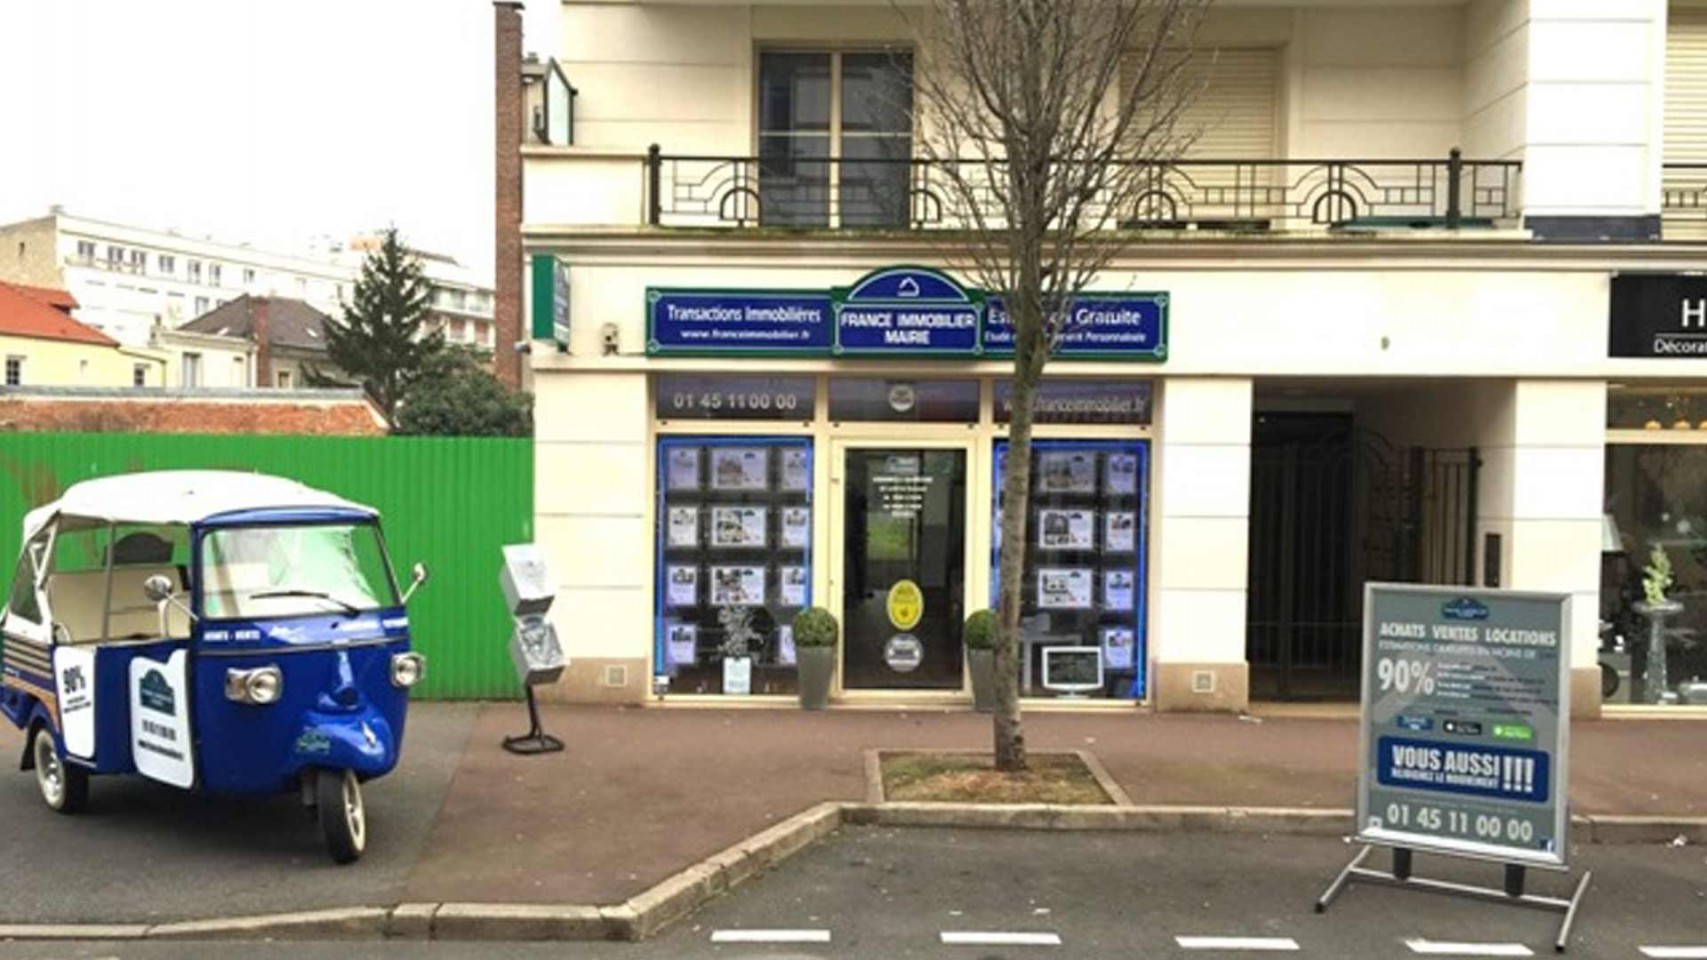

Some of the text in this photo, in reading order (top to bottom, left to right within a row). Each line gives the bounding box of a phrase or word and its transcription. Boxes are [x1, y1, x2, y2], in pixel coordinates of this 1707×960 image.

[667, 303, 742, 321] Transactions
[841, 312, 976, 328] FRANCE IMMOBILIER
[1075, 308, 1141, 325] Gratuite
[884, 330, 930, 344] MAIRIE
[674, 393, 797, 409] 01 45 11 00 00
[1379, 622, 1557, 646] ACHATS VENTES LOCATIONS
[1377, 657, 1435, 695] 90%
[1391, 744, 1441, 771] VOUS
[1444, 750, 1500, 776] AUSSI
[1387, 804, 1533, 842] 01 45 11 00 00
